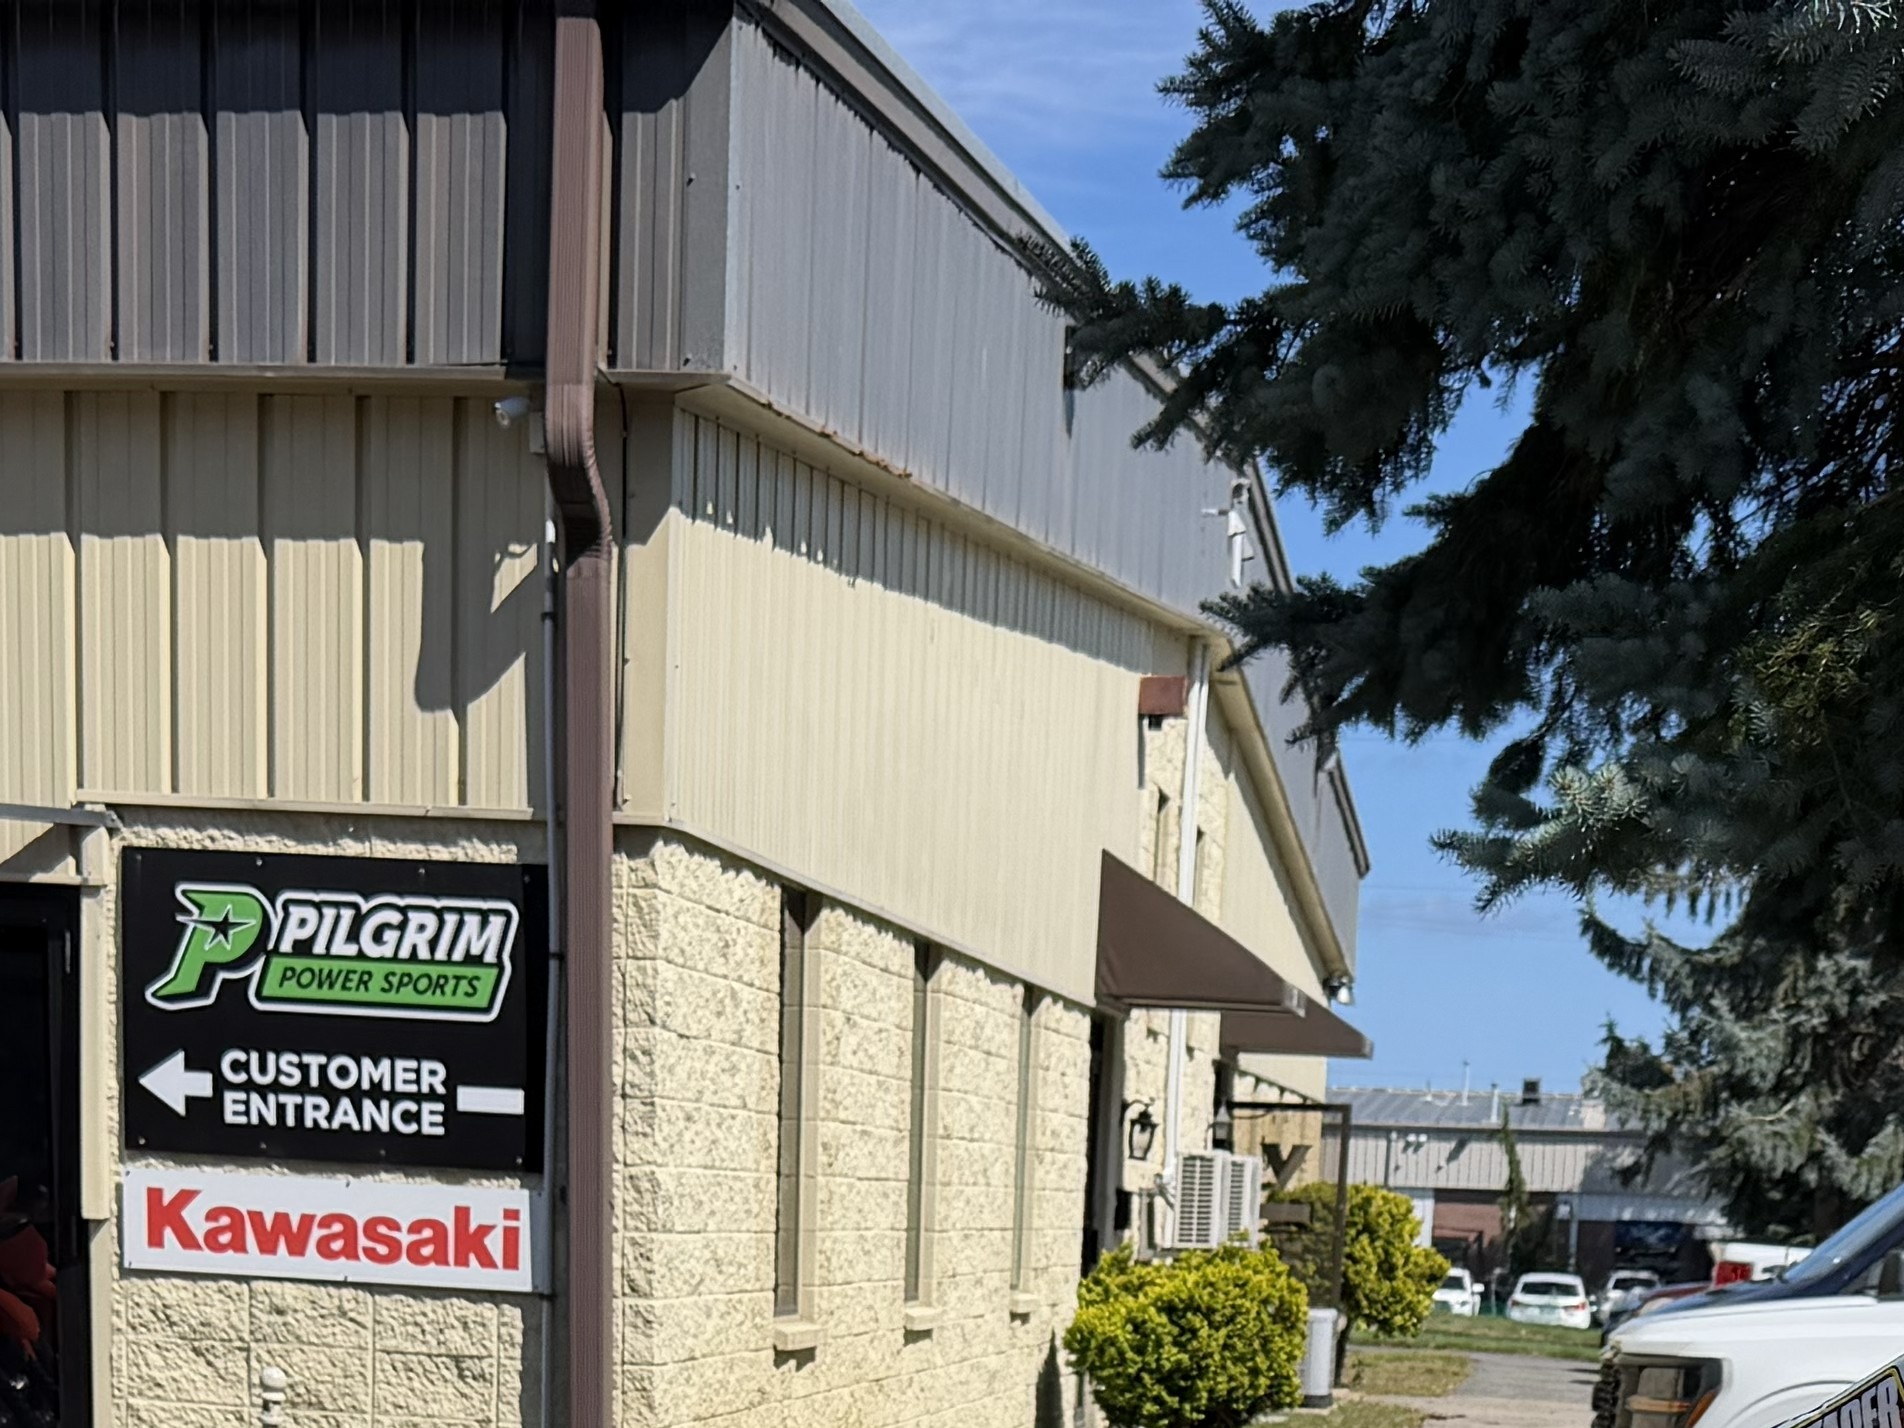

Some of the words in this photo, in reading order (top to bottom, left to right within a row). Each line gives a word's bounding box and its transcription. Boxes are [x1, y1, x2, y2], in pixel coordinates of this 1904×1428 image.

[278, 904, 507, 963] PILGRIM
[279, 966, 370, 993] POWER
[381, 971, 482, 998] SPORTS
[220, 1048, 447, 1095] CUSTOMER
[224, 1092, 446, 1136] ENTRANCE
[146, 1186, 520, 1271] Kawasaki
